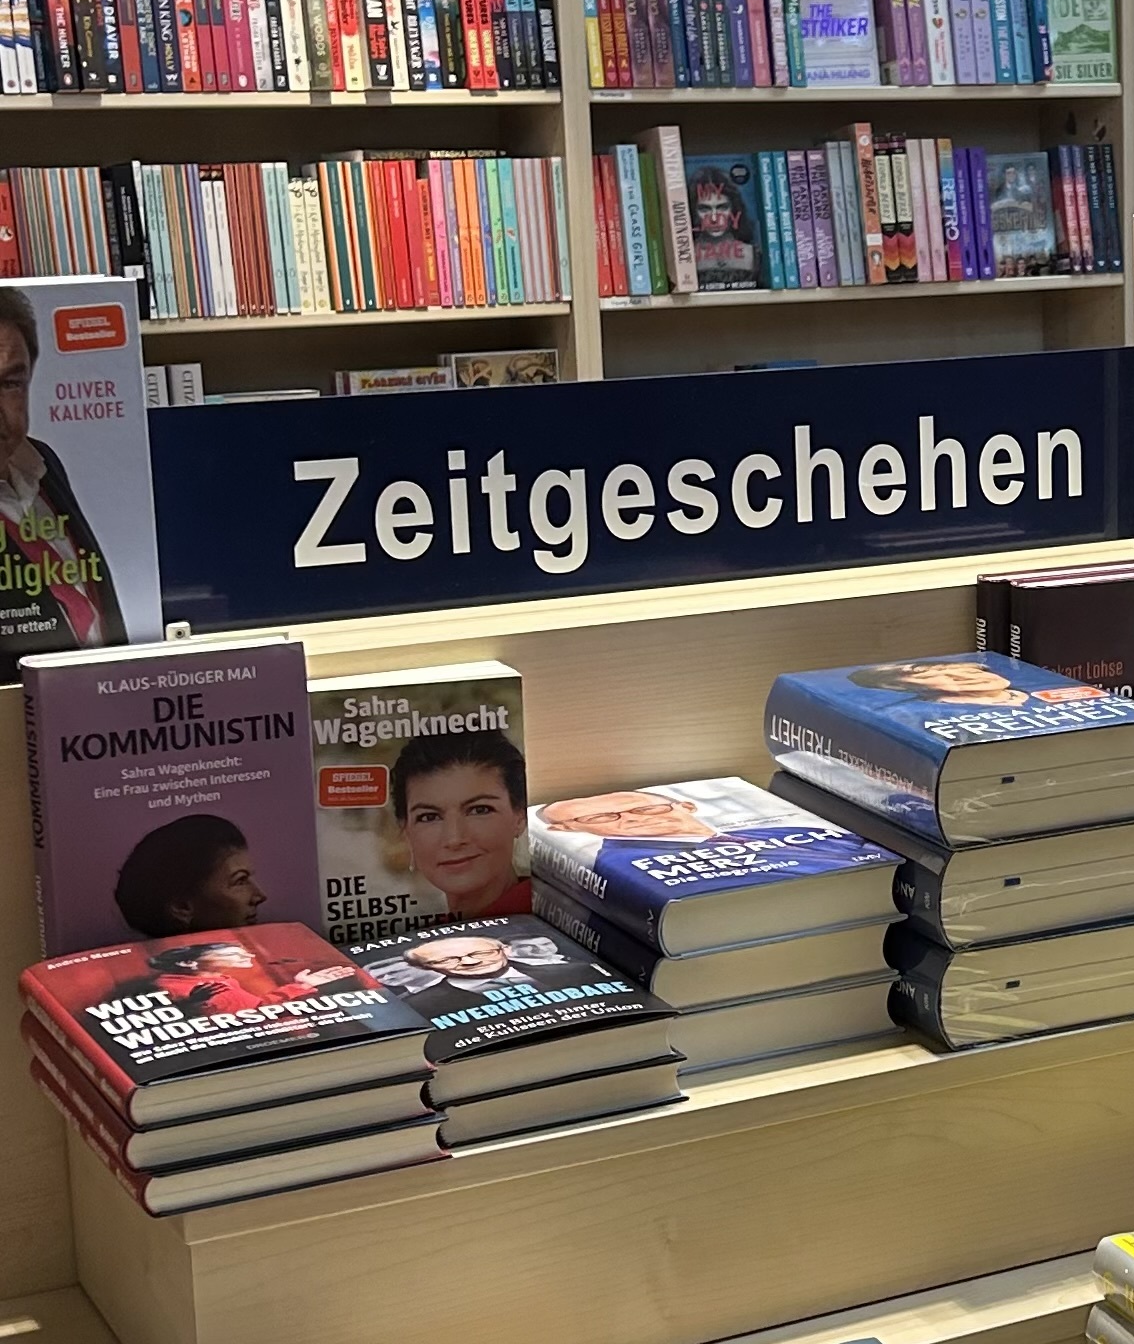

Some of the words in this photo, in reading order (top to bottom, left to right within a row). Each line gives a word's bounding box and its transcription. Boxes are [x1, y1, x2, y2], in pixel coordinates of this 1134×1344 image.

[159, 9, 173, 41] KING
[809, 4, 832, 18] THE
[105, 8, 119, 60] DEAVER
[313, 14, 326, 57] WOODS
[801, 17, 868, 38] STRIKER
[57, 27, 71, 68] HUNTER
[164, 43, 175, 70] HOLLY
[1077, 63, 1113, 78] SILVER
[940, 177, 959, 241] RETRO
[55, 381, 116, 400] OLIVER
[50, 401, 125, 422] KALKOFE
[293, 416, 1083, 574] Zeitgeschehen
[98, 670, 225, 694] KLAUS-RÜDIGER
[228, 666, 257, 681] MAI
[153, 694, 205, 723] DIE
[344, 696, 410, 718] Sahra
[924, 705, 1036, 728] ANGELA
[1041, 697, 1128, 714] MERKEL
[59, 712, 296, 763] KOMMUNISTIN
[314, 706, 509, 748] Wagenknecht
[121, 764, 155, 780] Sahra
[631, 828, 844, 870] FRIEDRICH
[647, 854, 768, 881] MERZ
[700, 860, 800, 880] Biographie
[326, 876, 367, 900] DIE
[326, 893, 419, 924] SELBST-
[350, 935, 412, 956] SARA
[418, 917, 510, 940] SIEVERT
[85, 990, 172, 1021] WUT
[483, 983, 541, 1003] DER
[100, 1007, 185, 1036] UND
[113, 990, 388, 1051] WIDERSPRUCH
